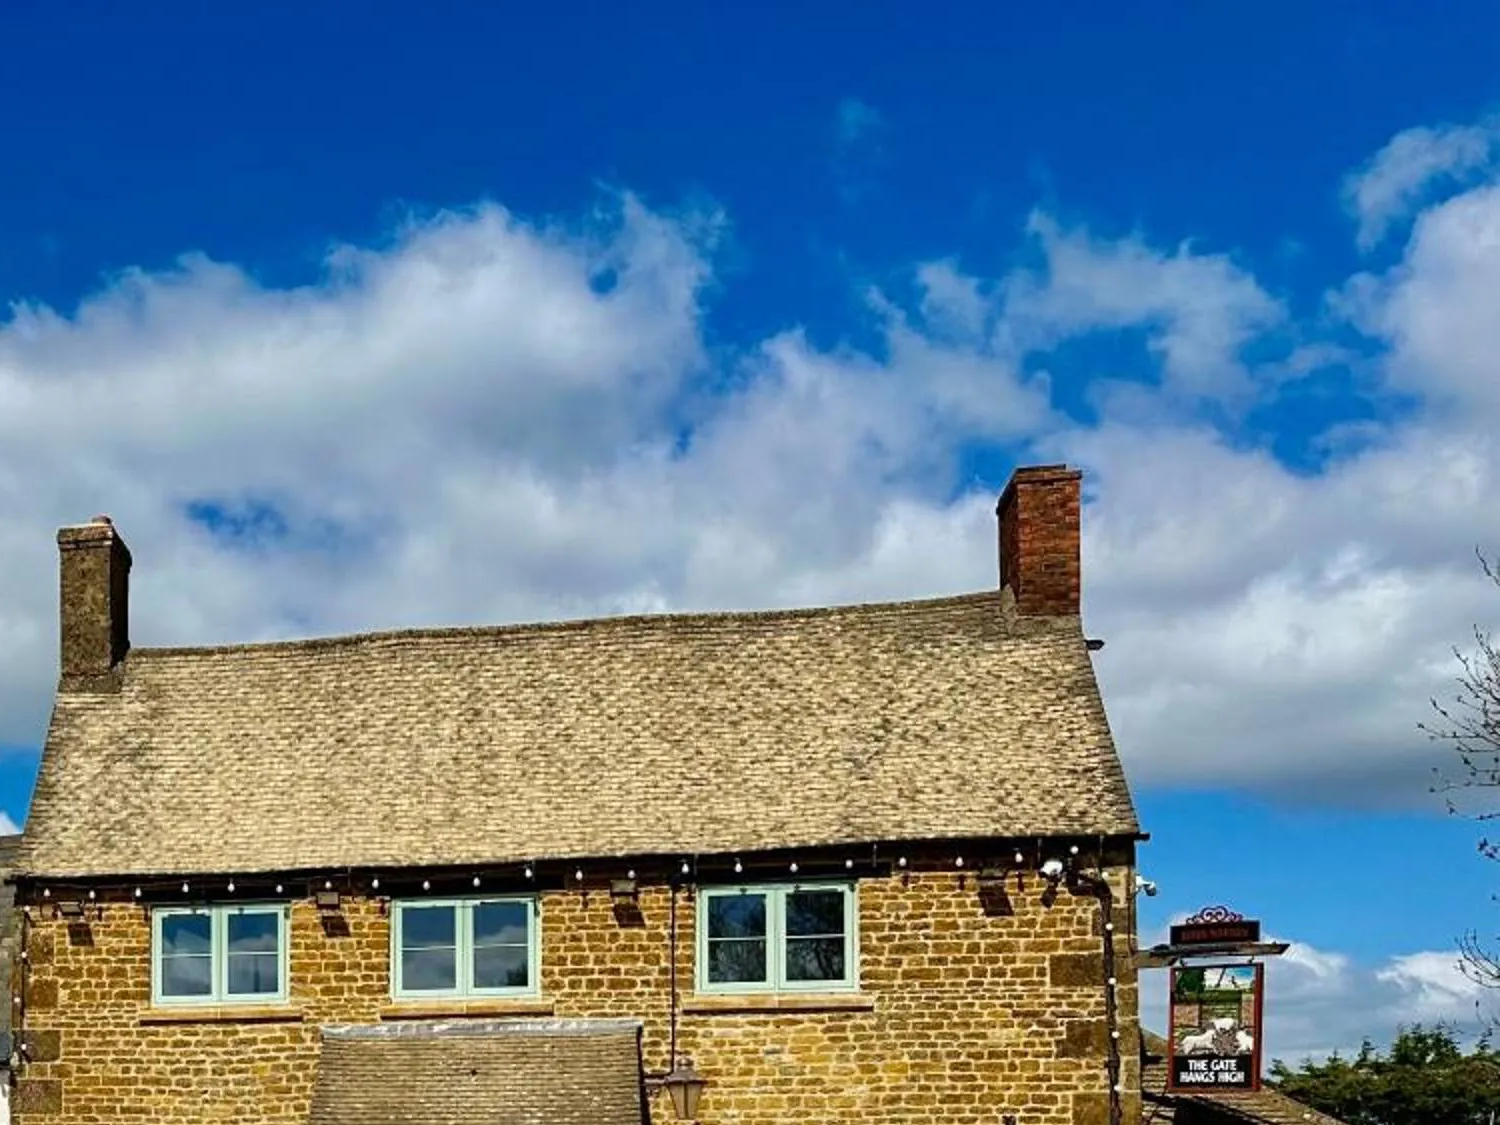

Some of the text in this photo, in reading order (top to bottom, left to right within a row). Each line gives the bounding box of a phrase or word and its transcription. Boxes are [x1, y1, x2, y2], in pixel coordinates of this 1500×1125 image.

[1187, 1059, 1237, 1071] THE GATE
[1179, 1071, 1245, 1083] HANGS HIGH
